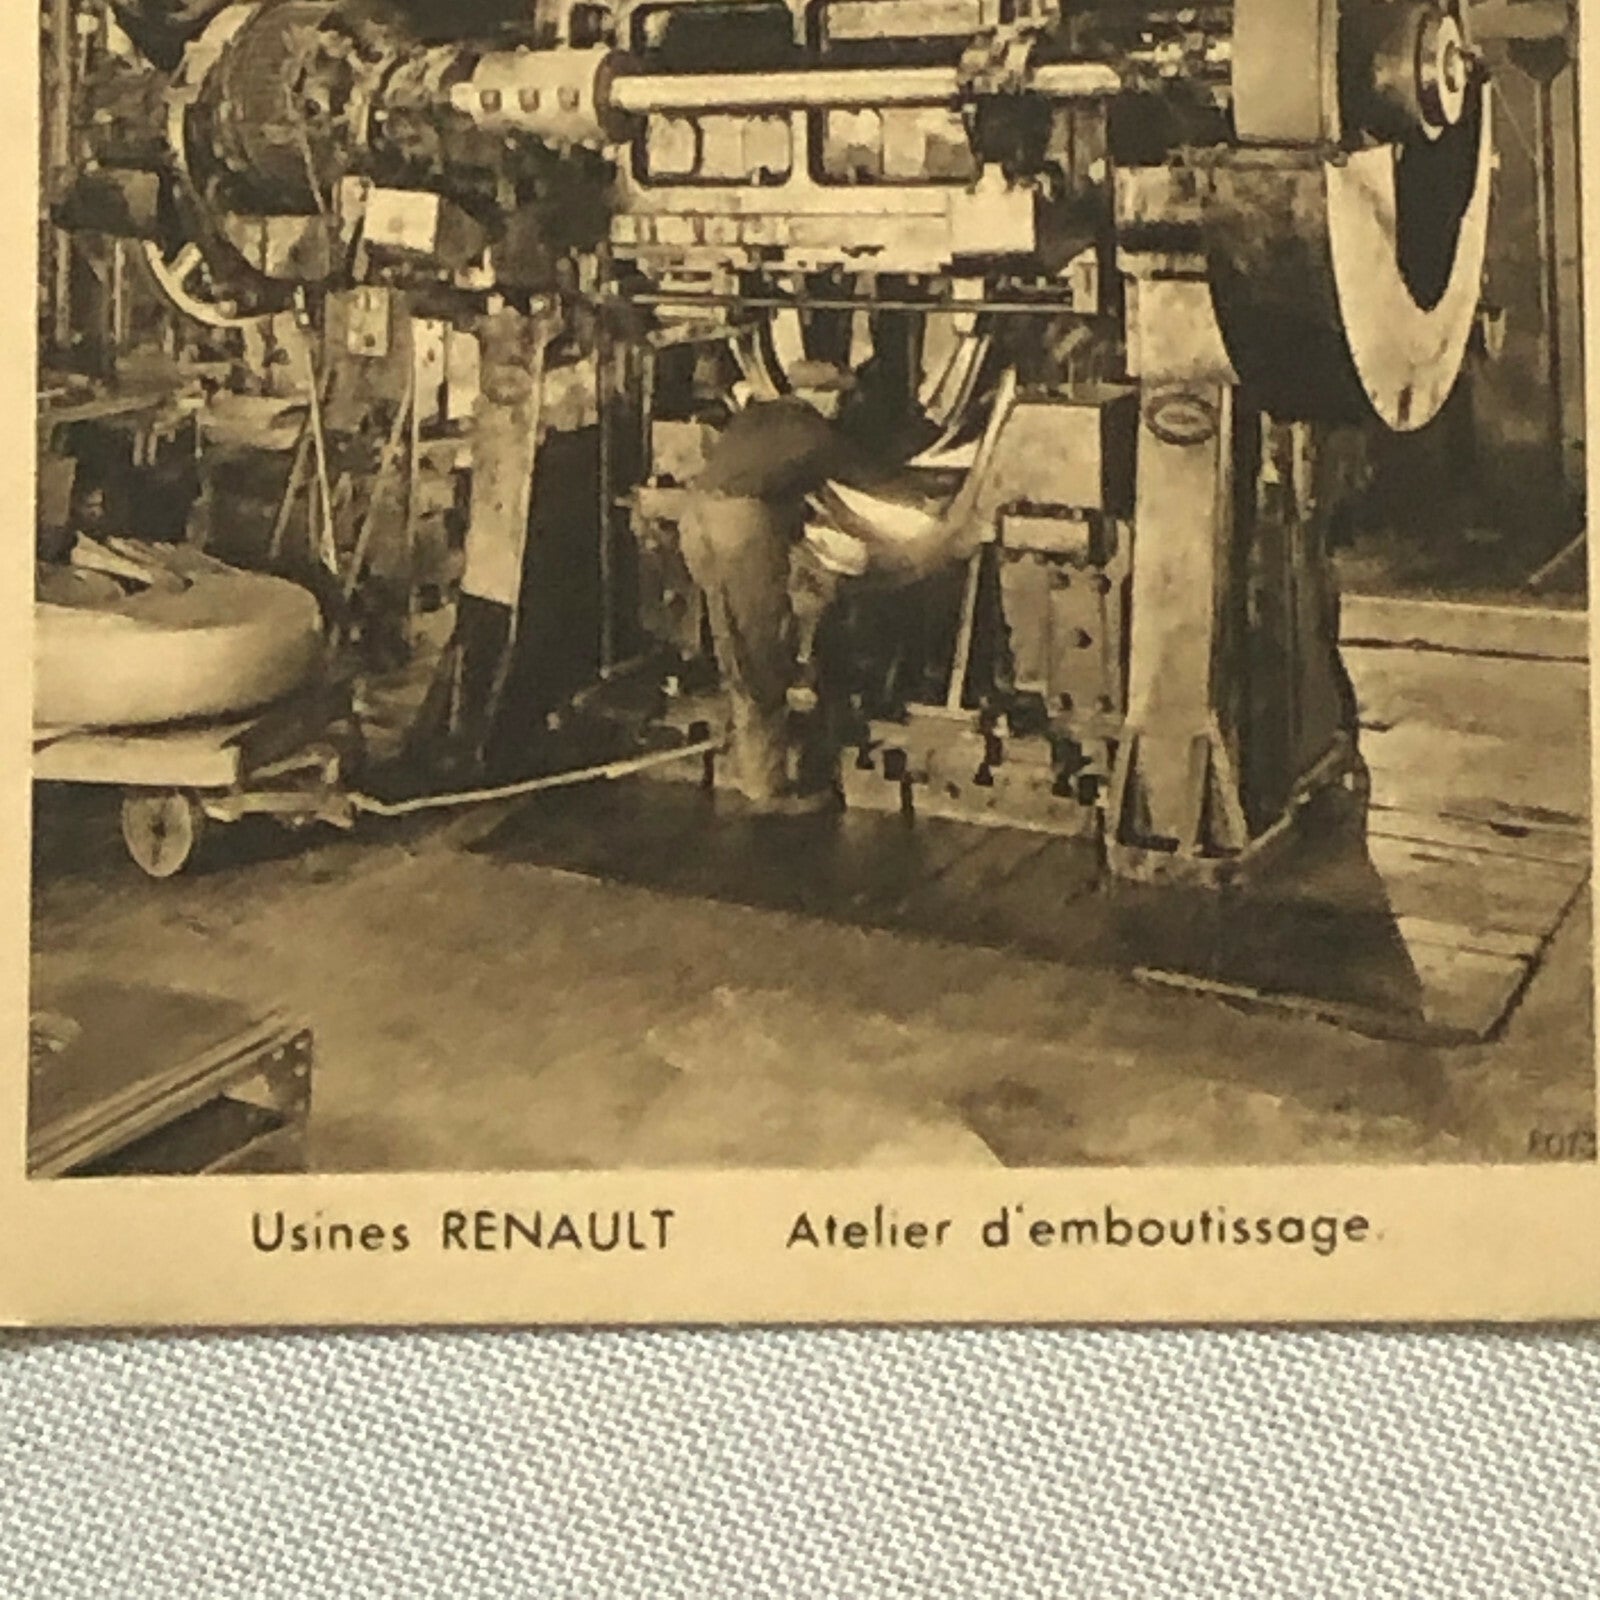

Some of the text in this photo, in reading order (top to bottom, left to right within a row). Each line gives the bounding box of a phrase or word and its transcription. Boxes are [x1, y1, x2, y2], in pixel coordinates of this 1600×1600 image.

[251, 1209, 410, 1253] Usines
[441, 1208, 676, 1252] RENAULT
[785, 1203, 952, 1250] Atelier
